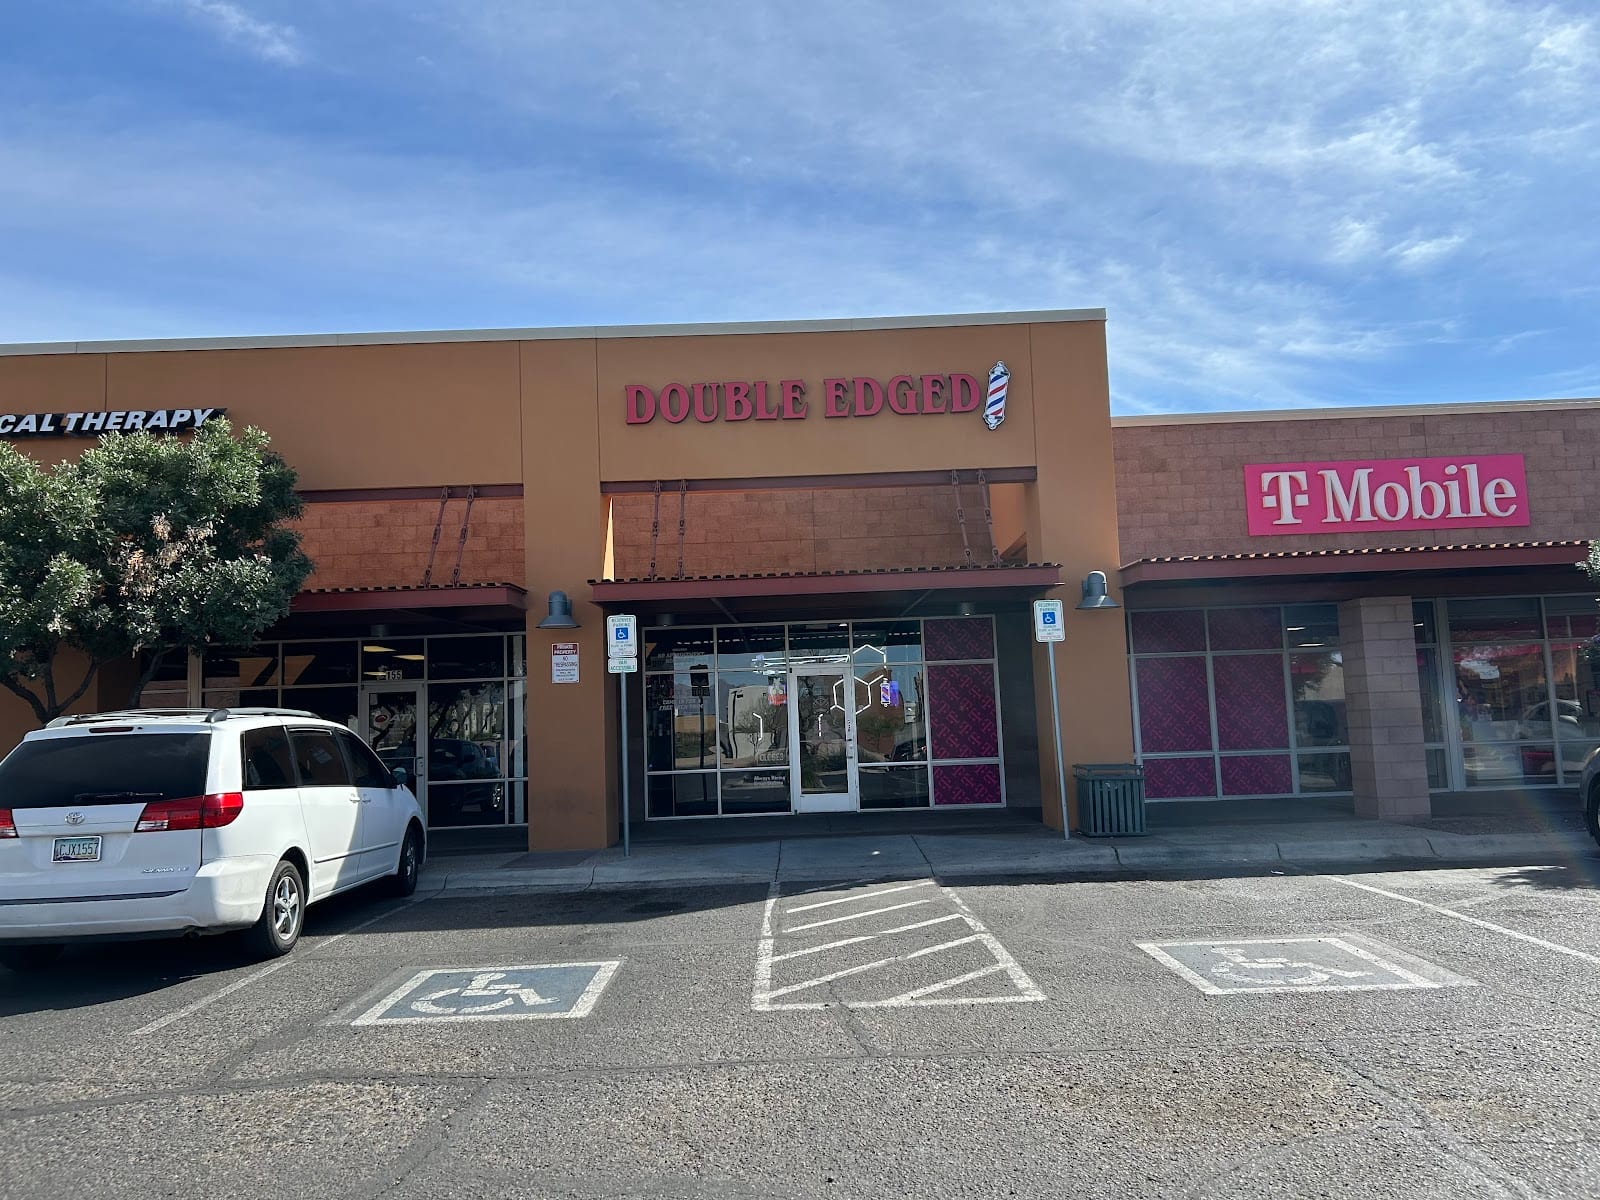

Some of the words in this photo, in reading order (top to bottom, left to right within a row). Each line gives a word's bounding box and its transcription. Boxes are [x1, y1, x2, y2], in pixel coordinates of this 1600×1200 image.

[0, 413, 55, 434] CAL
[65, 408, 214, 431] THERAPY
[625, 380, 808, 424] DOUBLE
[824, 373, 981, 417] EDGED
[1317, 463, 1518, 523] Mobile
